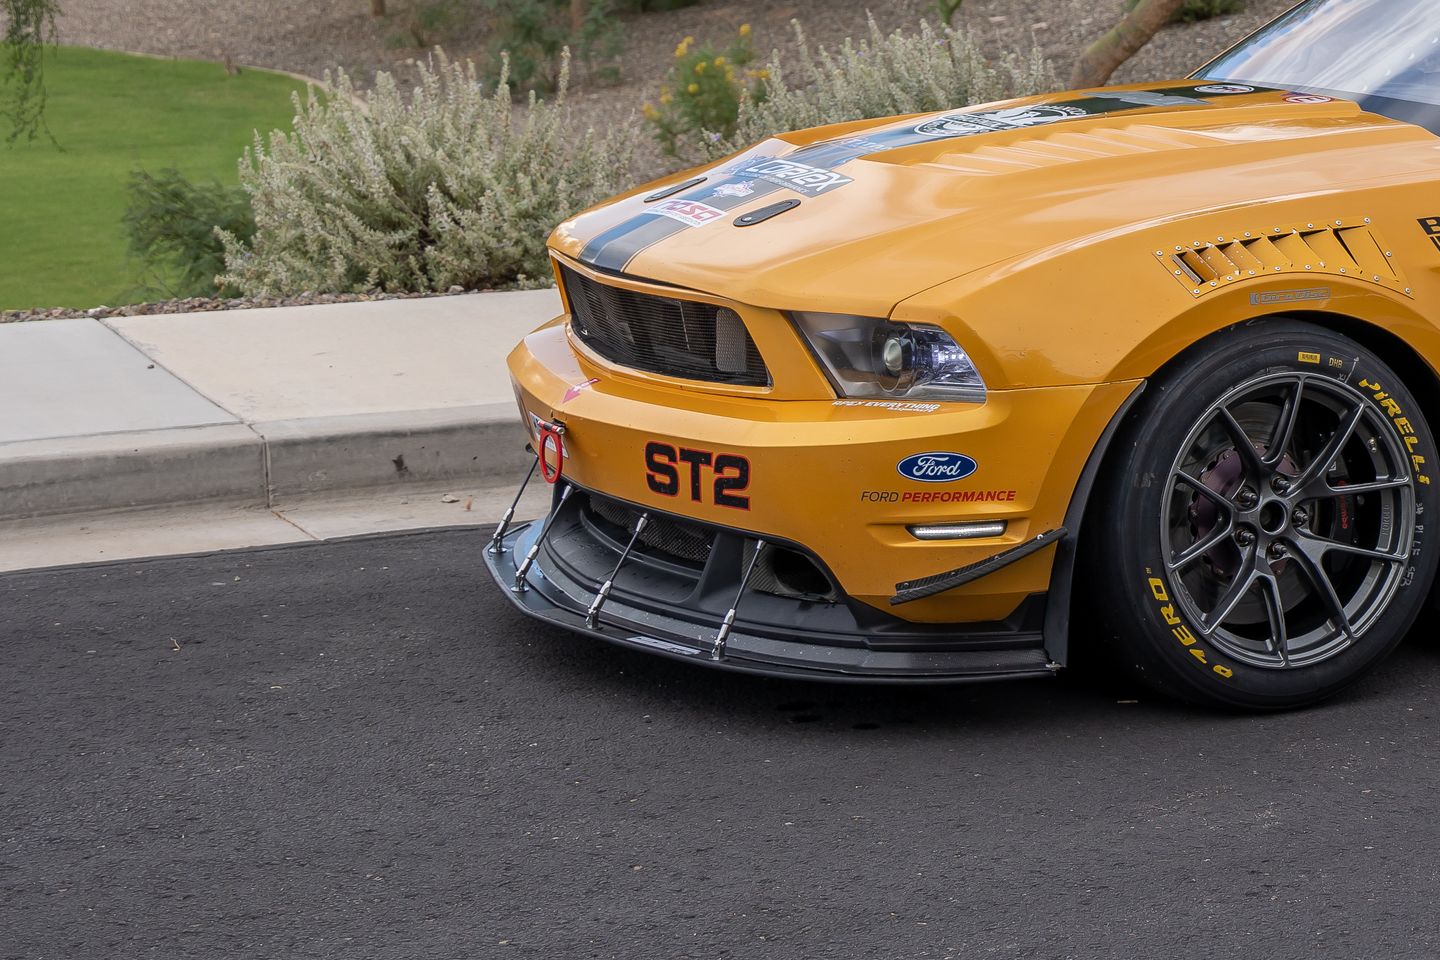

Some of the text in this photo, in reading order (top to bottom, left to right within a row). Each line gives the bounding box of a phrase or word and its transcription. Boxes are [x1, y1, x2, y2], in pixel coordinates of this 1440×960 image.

[1358, 378, 1431, 486] PIRELLI
[643, 439, 752, 512] ST2
[911, 455, 962, 477] Ford
[861, 490, 1017, 503] FORD PERFORMANCE
